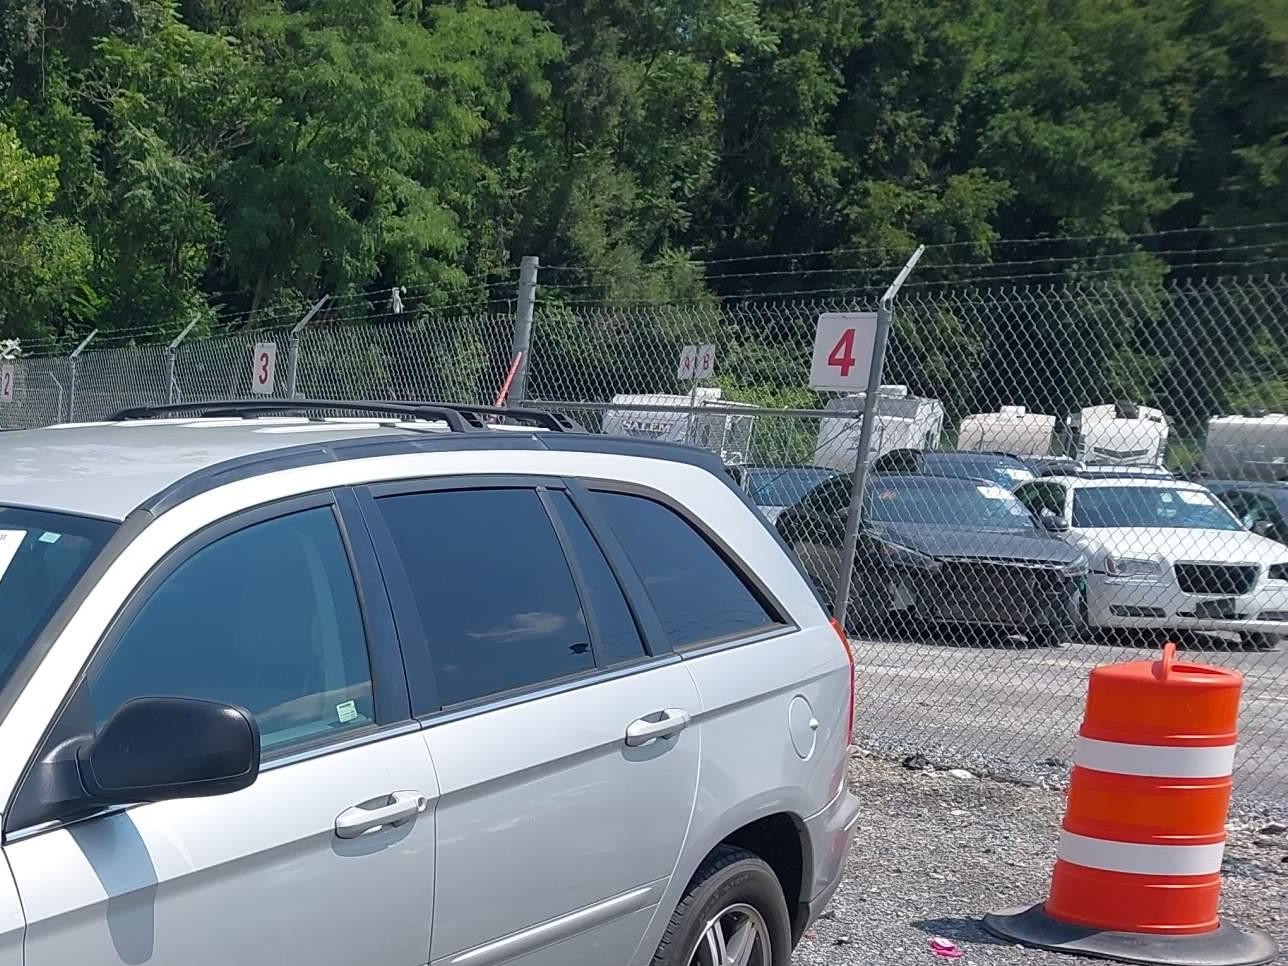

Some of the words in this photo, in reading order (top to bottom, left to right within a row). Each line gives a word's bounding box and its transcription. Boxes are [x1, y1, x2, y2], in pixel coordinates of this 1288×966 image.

[828, 328, 856, 376] 4
[259, 352, 269, 384] 3
[4, 372, 11, 396] 2
[622, 419, 673, 433] SALEM
